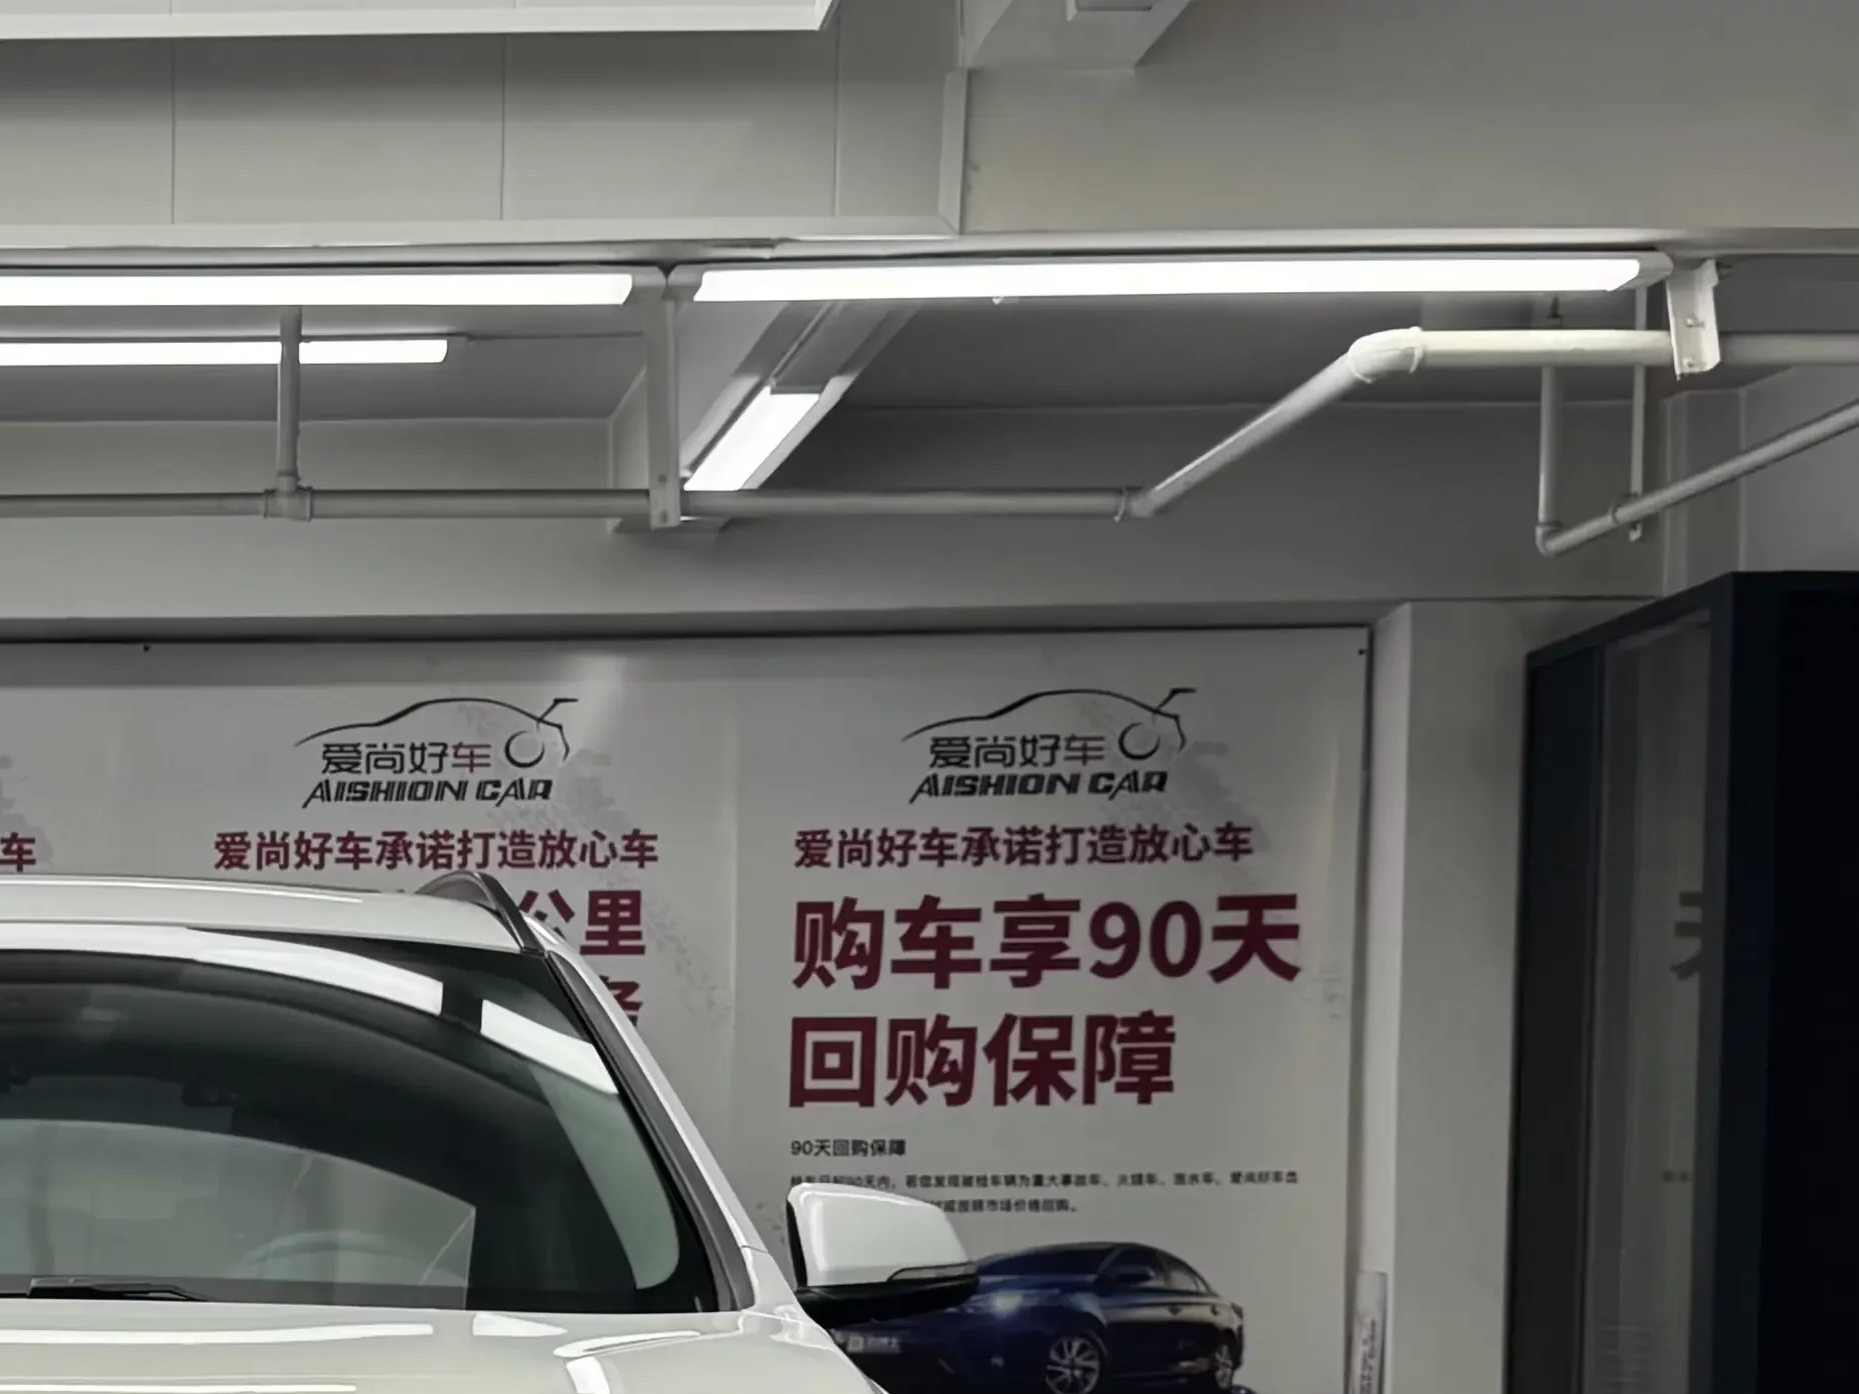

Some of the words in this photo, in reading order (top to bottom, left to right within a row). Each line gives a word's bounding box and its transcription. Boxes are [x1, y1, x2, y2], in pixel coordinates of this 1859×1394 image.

[321, 741, 492, 775] 爱尚好车
[929, 734, 1106, 769] 爱尚好车
[302, 778, 468, 809] AISHION
[475, 777, 553, 808] CAR
[909, 772, 1081, 804] AISHION
[1088, 770, 1169, 801] CAR
[214, 828, 659, 872] 爱尚好车承诺打造放心车
[794, 823, 1255, 869] 爱尚好车承诺打造放心车
[792, 892, 1302, 990] 购车享90天
[789, 1009, 1177, 1108] 回购保障
[791, 1139, 907, 1157] 90天回购保障
